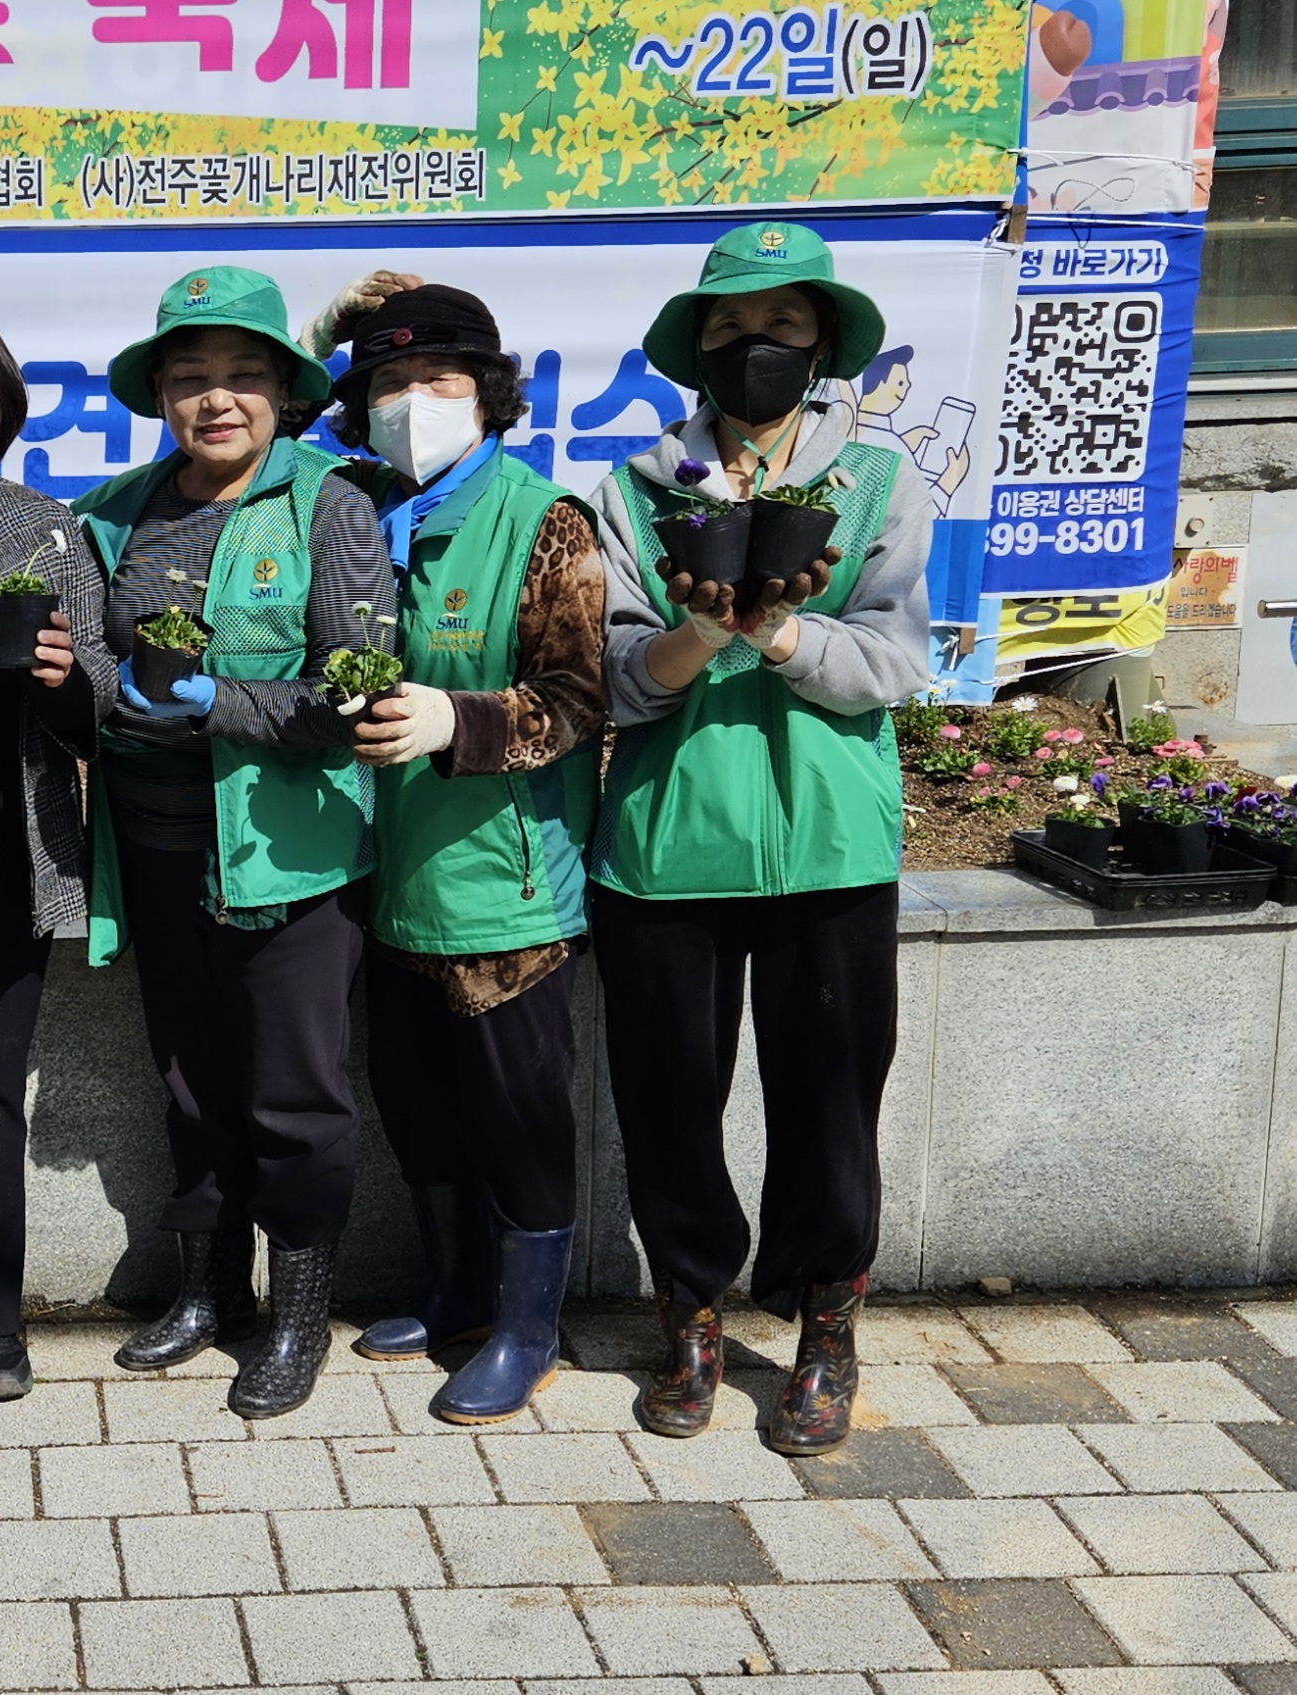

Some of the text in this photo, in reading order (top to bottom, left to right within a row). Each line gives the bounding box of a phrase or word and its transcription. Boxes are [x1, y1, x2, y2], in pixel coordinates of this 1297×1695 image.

[633, 9, 931, 95] ~22일(일)
[755, 247, 788, 260] SMU
[1052, 248, 1162, 278] 바로가기
[183, 296, 211, 310] SMU
[997, 486, 1145, 518] 이용권 상담센터
[248, 587, 283, 601] SMU
[436, 617, 469, 631] SMU
